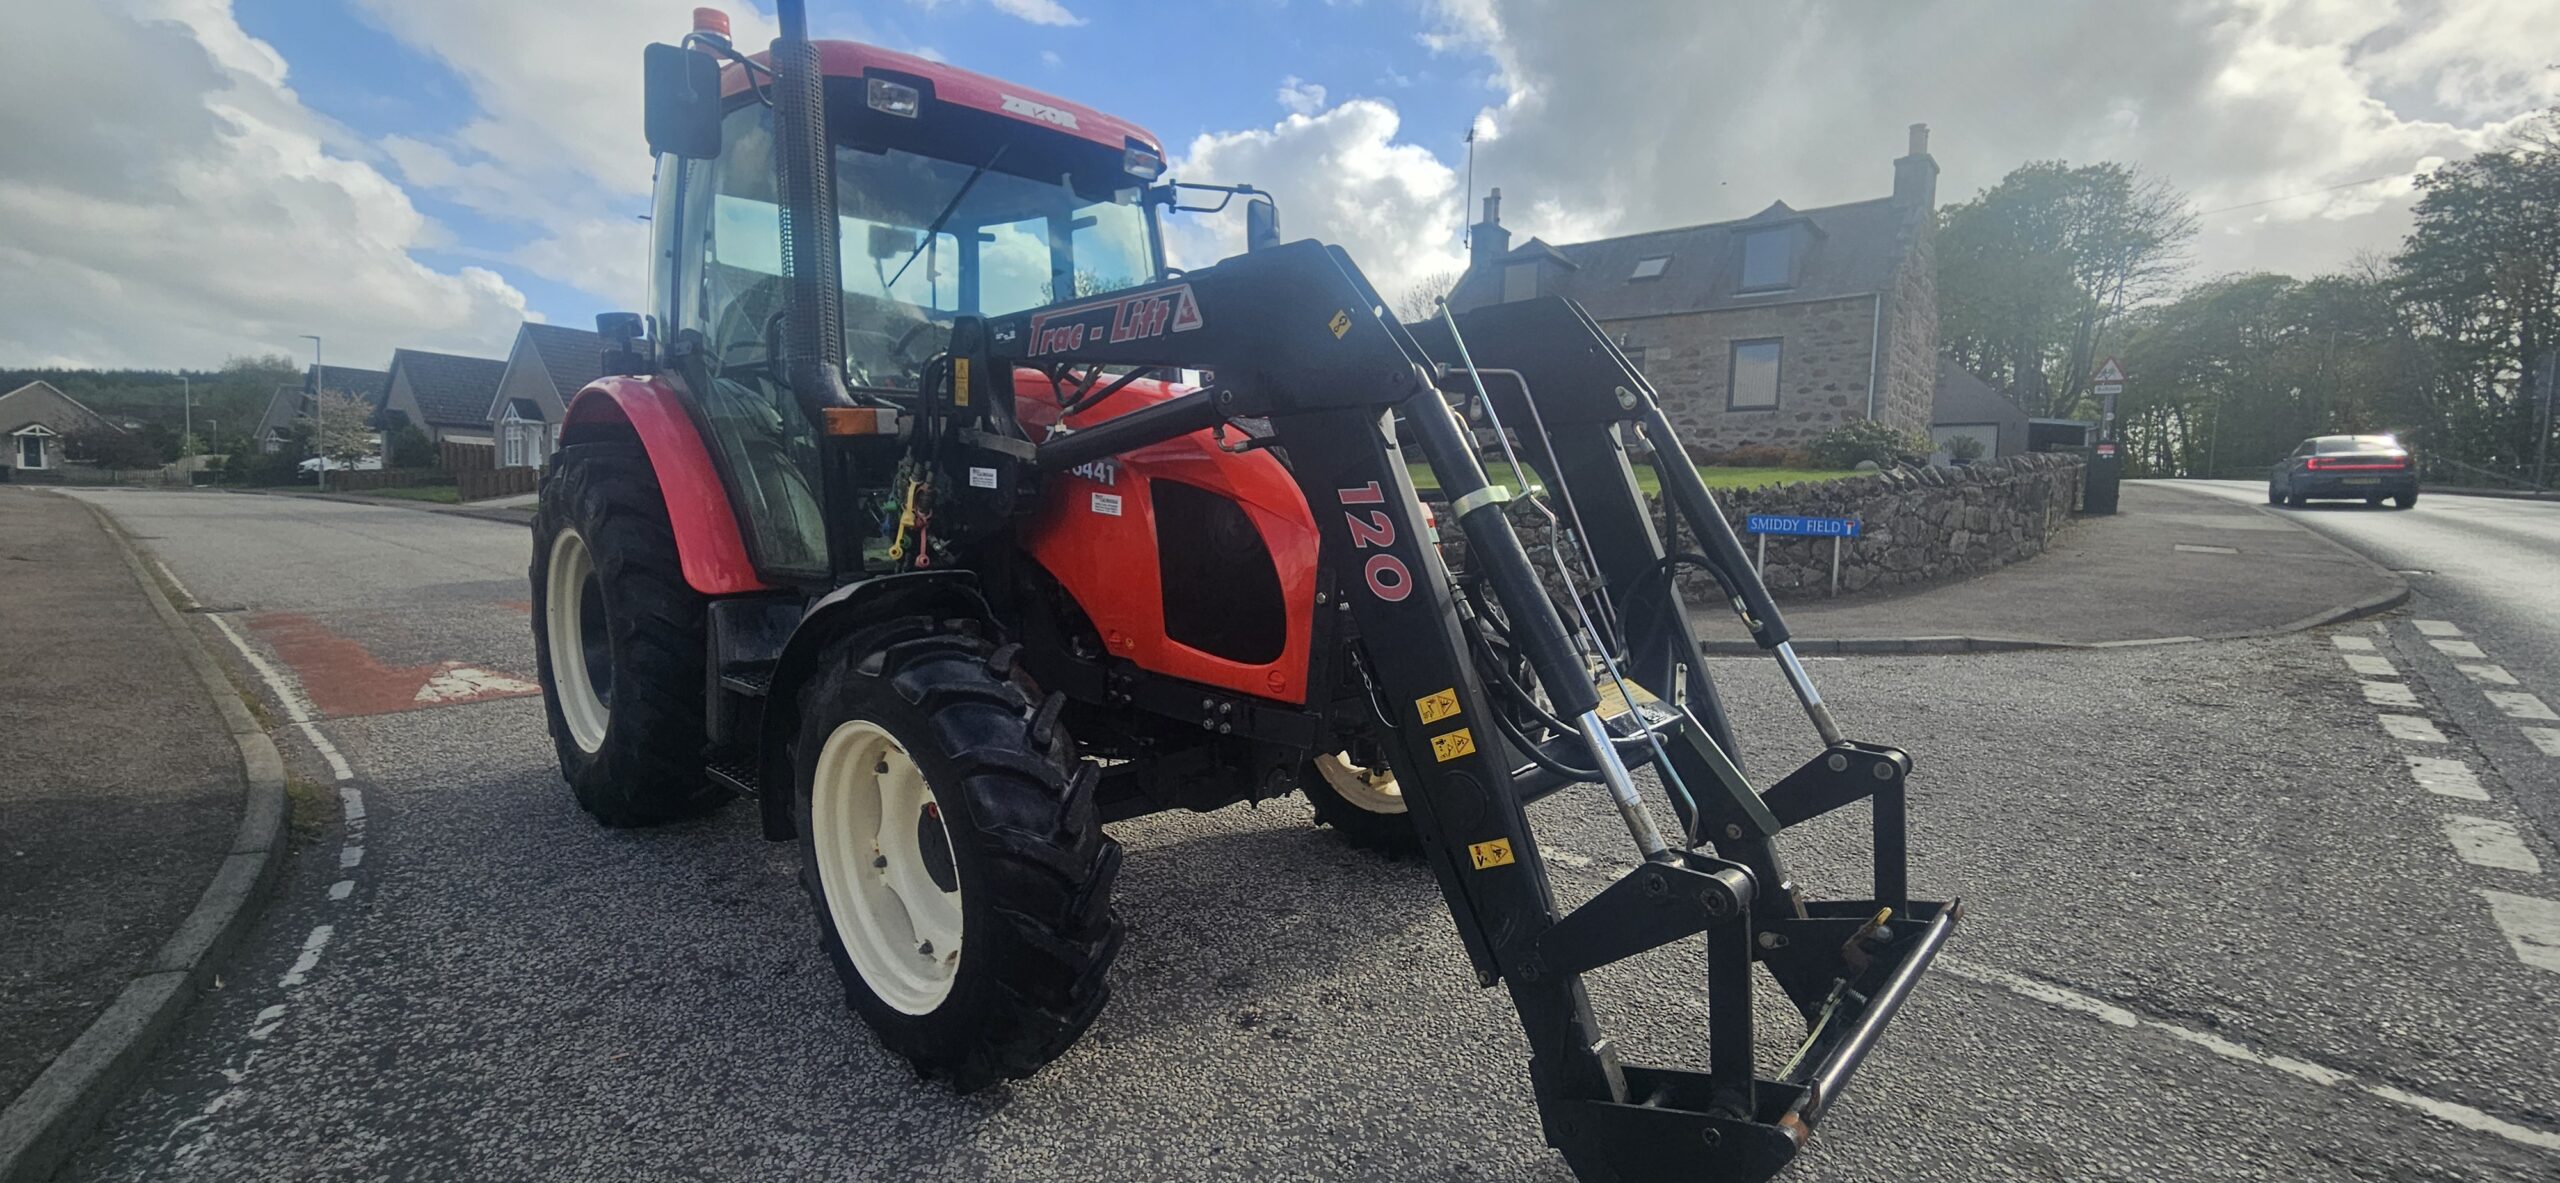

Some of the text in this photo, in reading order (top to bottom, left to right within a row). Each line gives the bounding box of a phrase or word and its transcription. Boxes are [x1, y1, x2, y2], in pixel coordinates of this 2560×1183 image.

[1027, 311, 1085, 357] Trac
[1110, 297, 1170, 343] Lift
[1338, 481, 1412, 602] 120
[1751, 518, 1840, 533] SMIDDY FIELD
